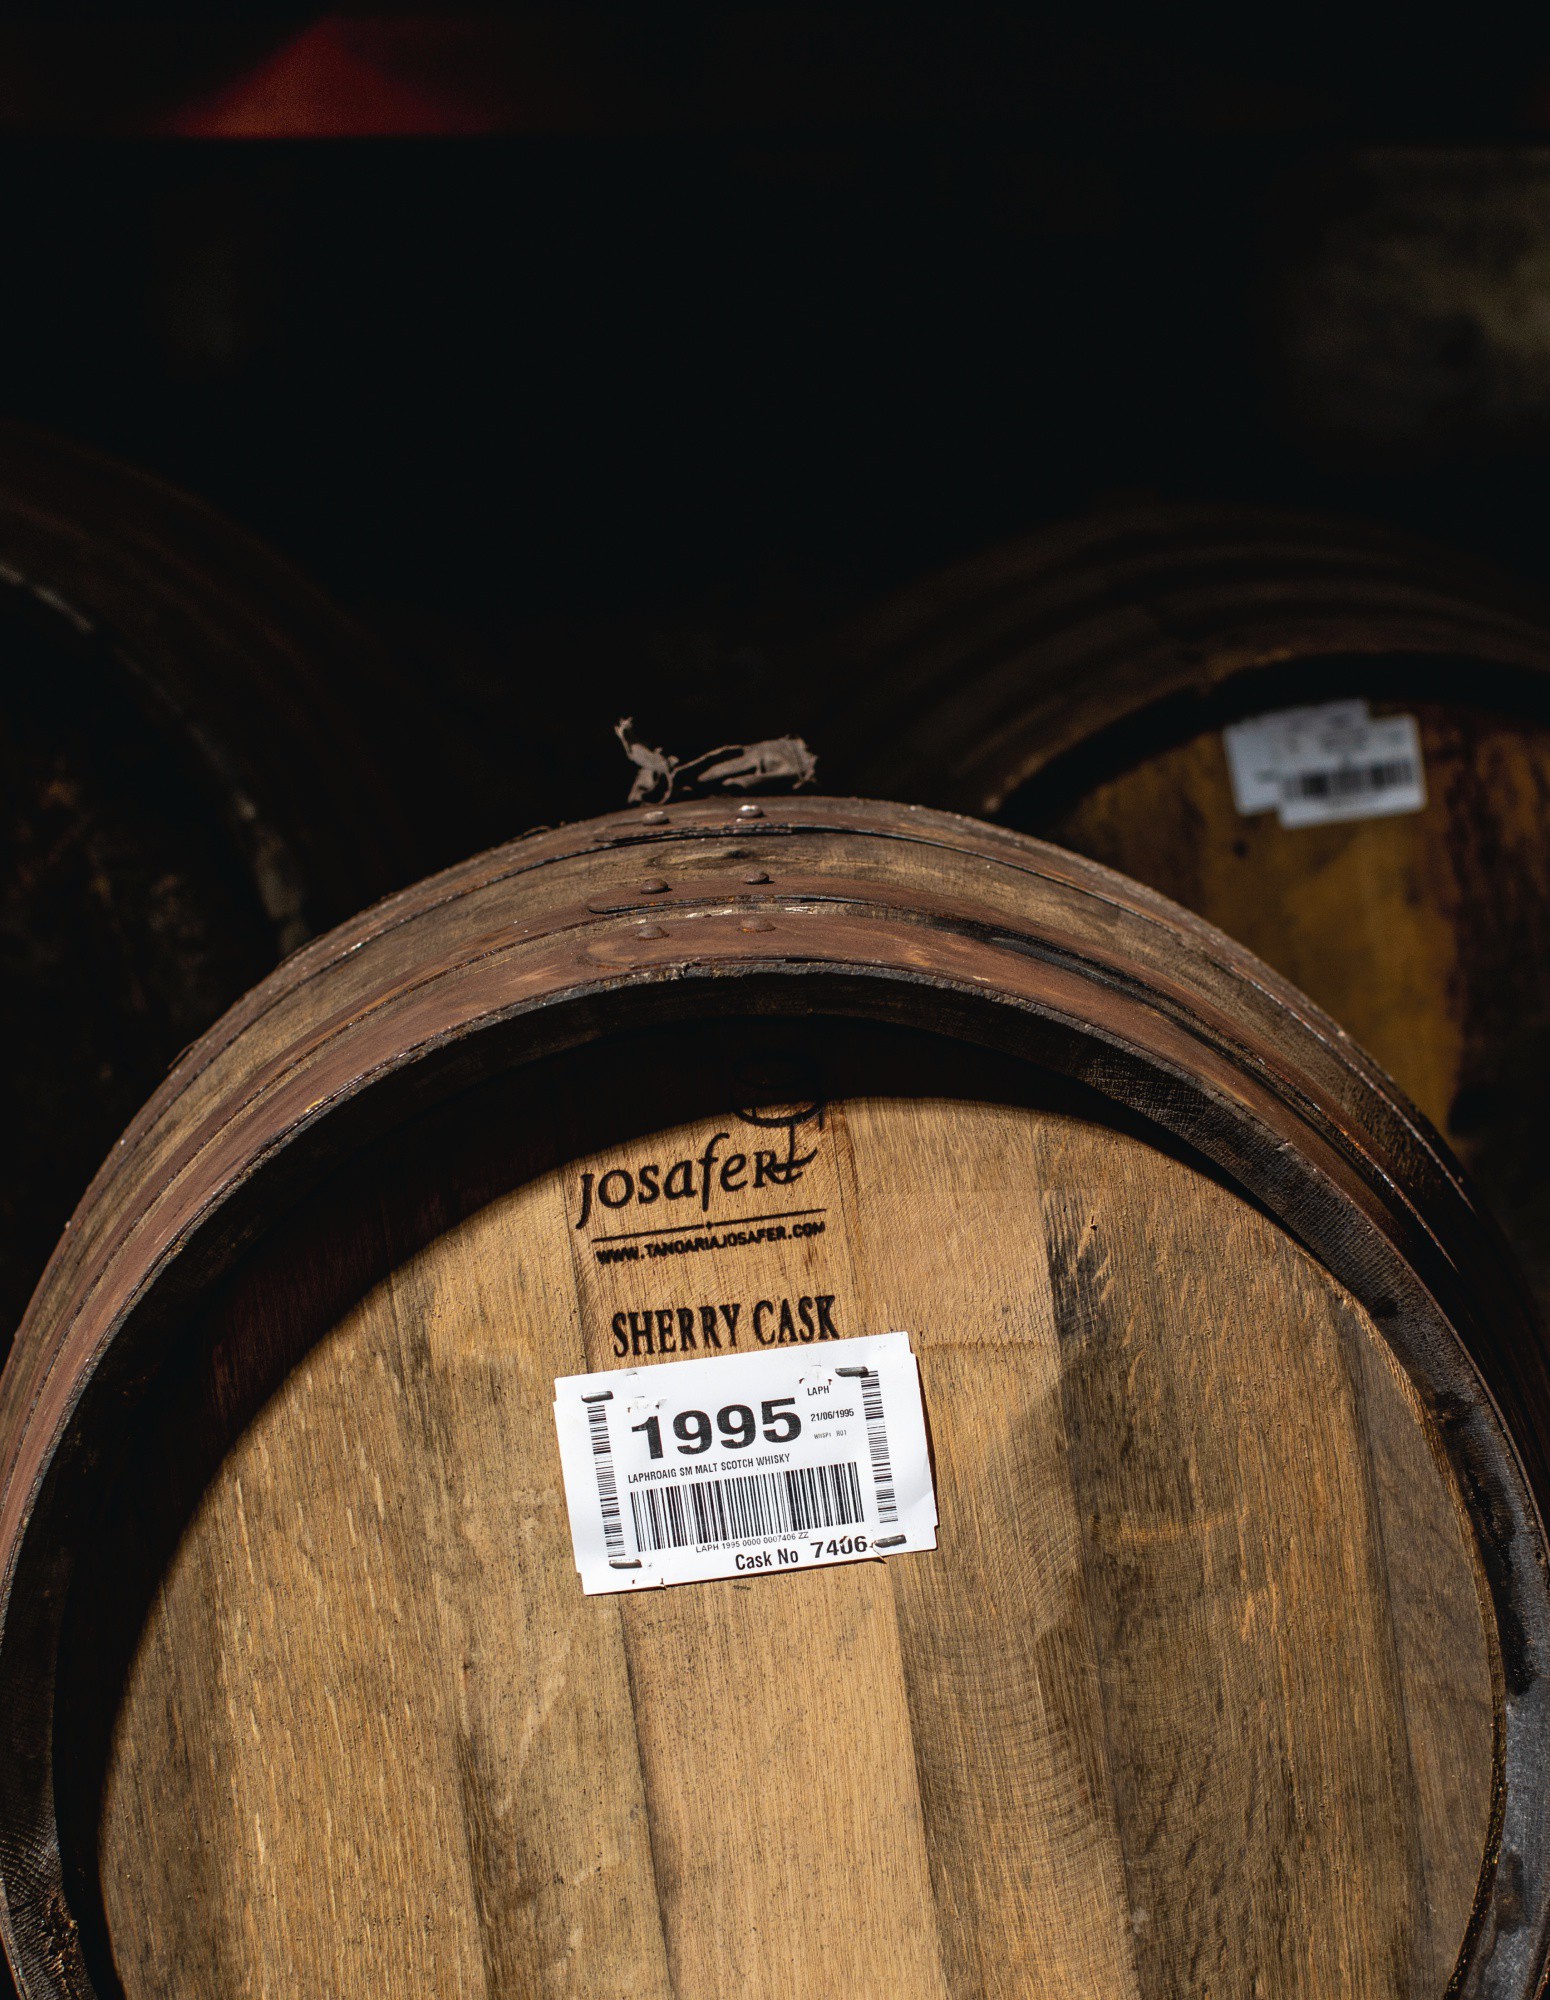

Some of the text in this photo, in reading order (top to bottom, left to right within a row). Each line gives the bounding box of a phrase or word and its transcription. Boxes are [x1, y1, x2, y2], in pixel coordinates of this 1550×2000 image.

[595, 1220, 826, 1264] WWW.TANOARIAJOSAFER.COM
[612, 1295, 840, 1358] SHERRY CASK
[807, 1385, 830, 1396] LAPH
[631, 1397, 802, 1460] 1995
[810, 1408, 855, 1422] 21/06/1995
[628, 1453, 791, 1484] LAPHROAIG SM MALT SCOTCH WHISKY
[695, 1531, 810, 1553] LAPH 1995 0000 0007406 ZZ
[735, 1535, 868, 1571] Cask No 7406
